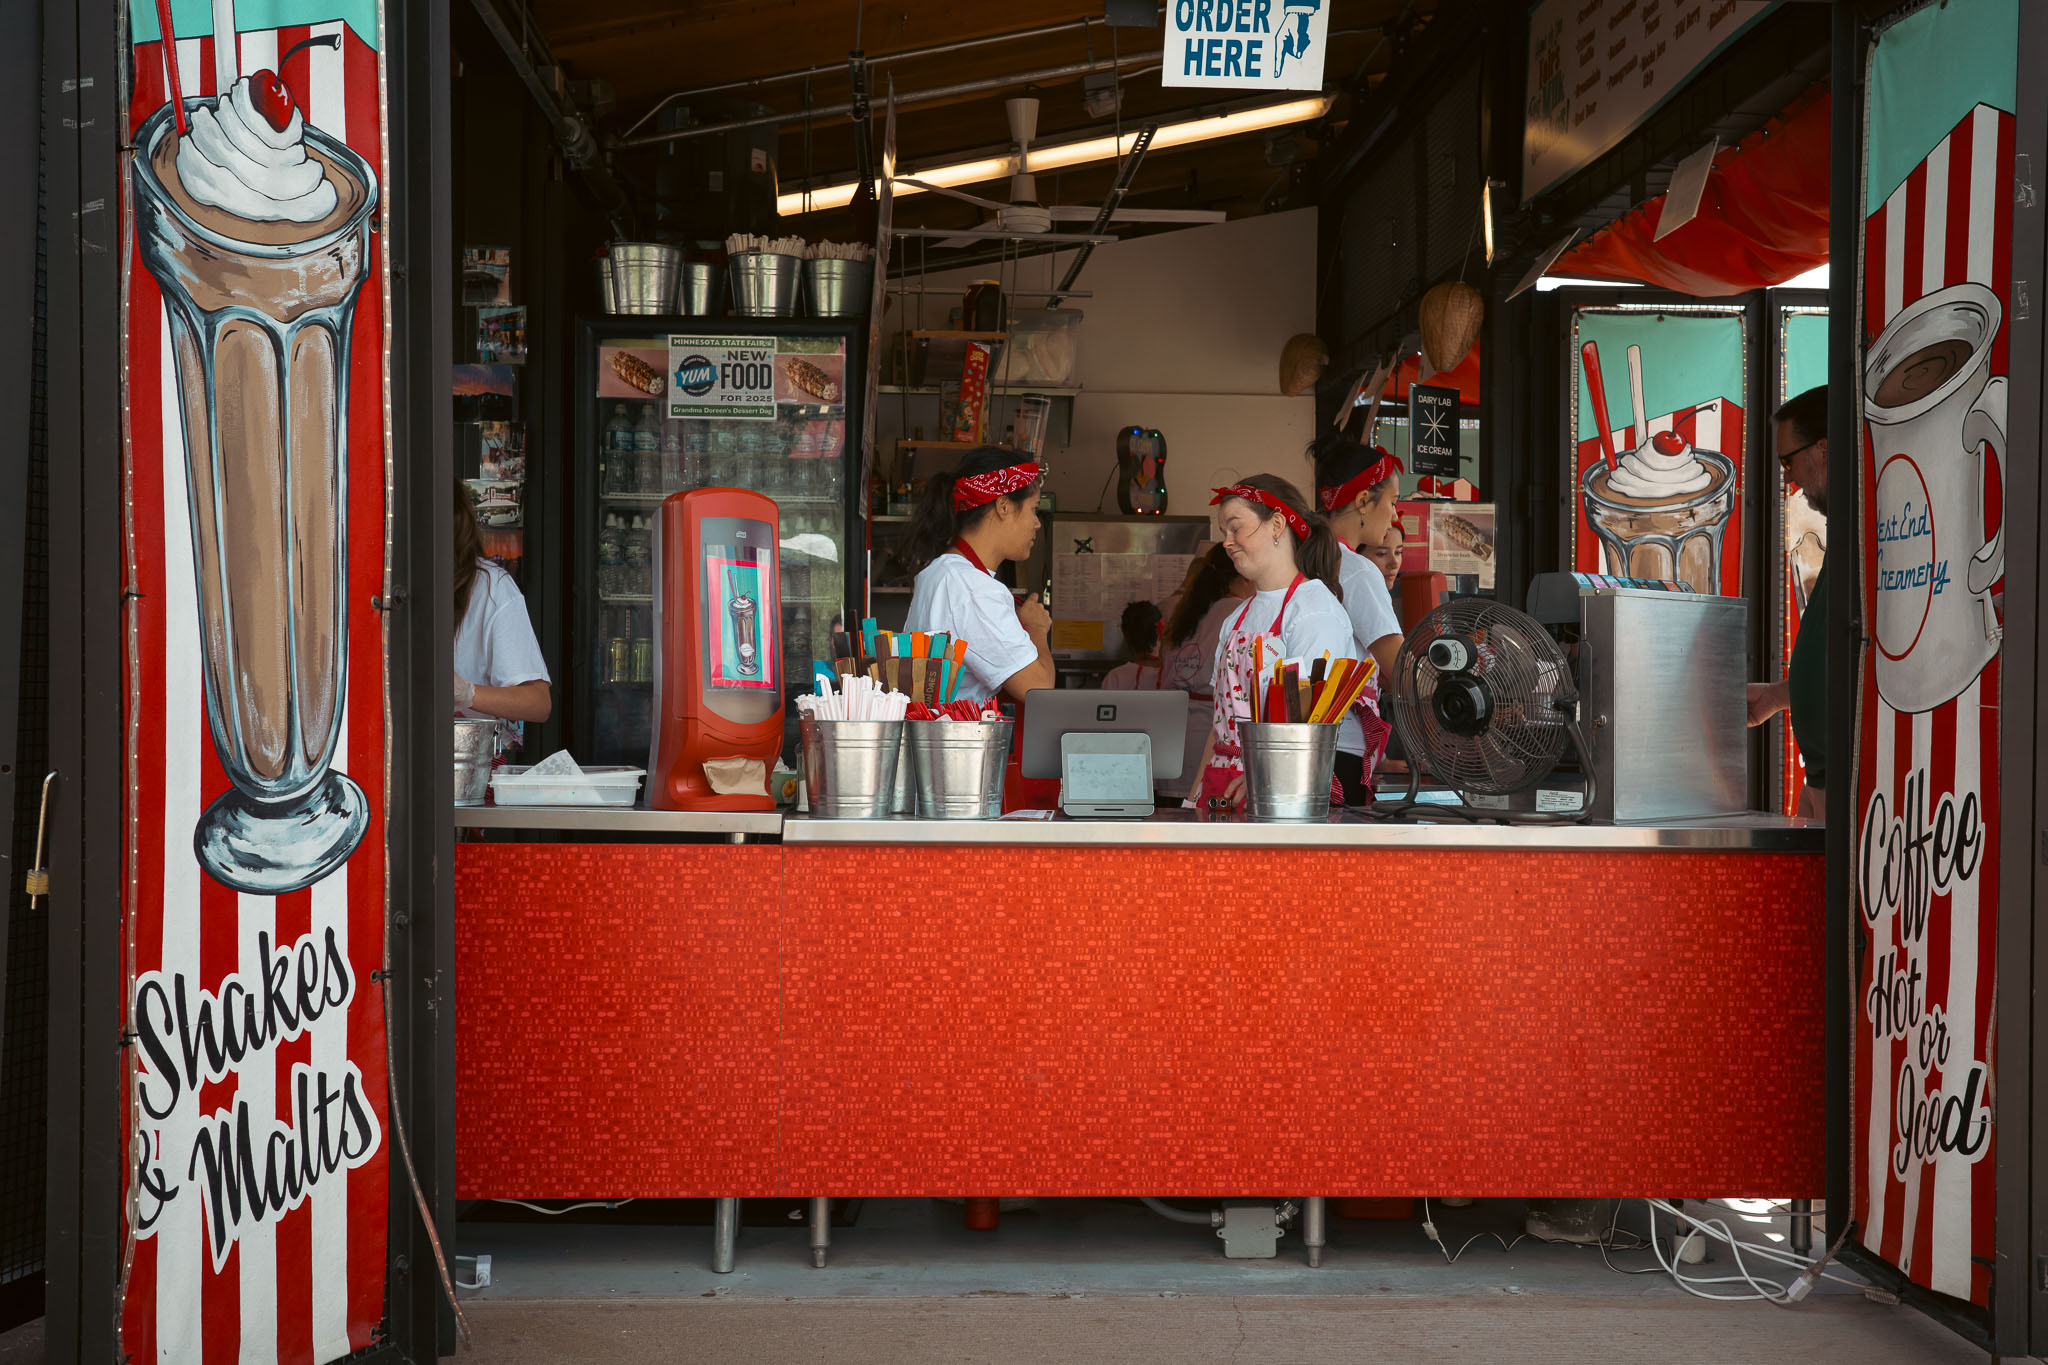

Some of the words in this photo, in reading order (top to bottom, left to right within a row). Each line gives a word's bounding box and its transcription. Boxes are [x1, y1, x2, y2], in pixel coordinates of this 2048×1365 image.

[1175, 0, 1272, 33] ORDER
[1184, 38, 1264, 78] HERE
[673, 338, 720, 346] MINNESOTA
[721, 339, 745, 347] STATE
[727, 350, 767, 361] NEW
[681, 367, 710, 385] YUM
[720, 363, 772, 390] FOOD
[673, 406, 703, 414] Grandma
[759, 409, 773, 417] Dog
[720, 394, 742, 402] FOR
[745, 395, 773, 403] 2025
[1418, 394, 1438, 404] DAIRY
[1438, 398, 1452, 407] LAB
[1417, 444, 1428, 454] ICE
[1428, 446, 1453, 457] CREAM
[1899, 501, 1931, 540] End
[1862, 767, 1982, 943] Coffee
[1868, 952, 1921, 1038] Hot
[136, 926, 350, 1121] Shakes
[1919, 1011, 1950, 1070] or
[1896, 1063, 1987, 1175] Iced
[188, 1071, 372, 1260] Malts
